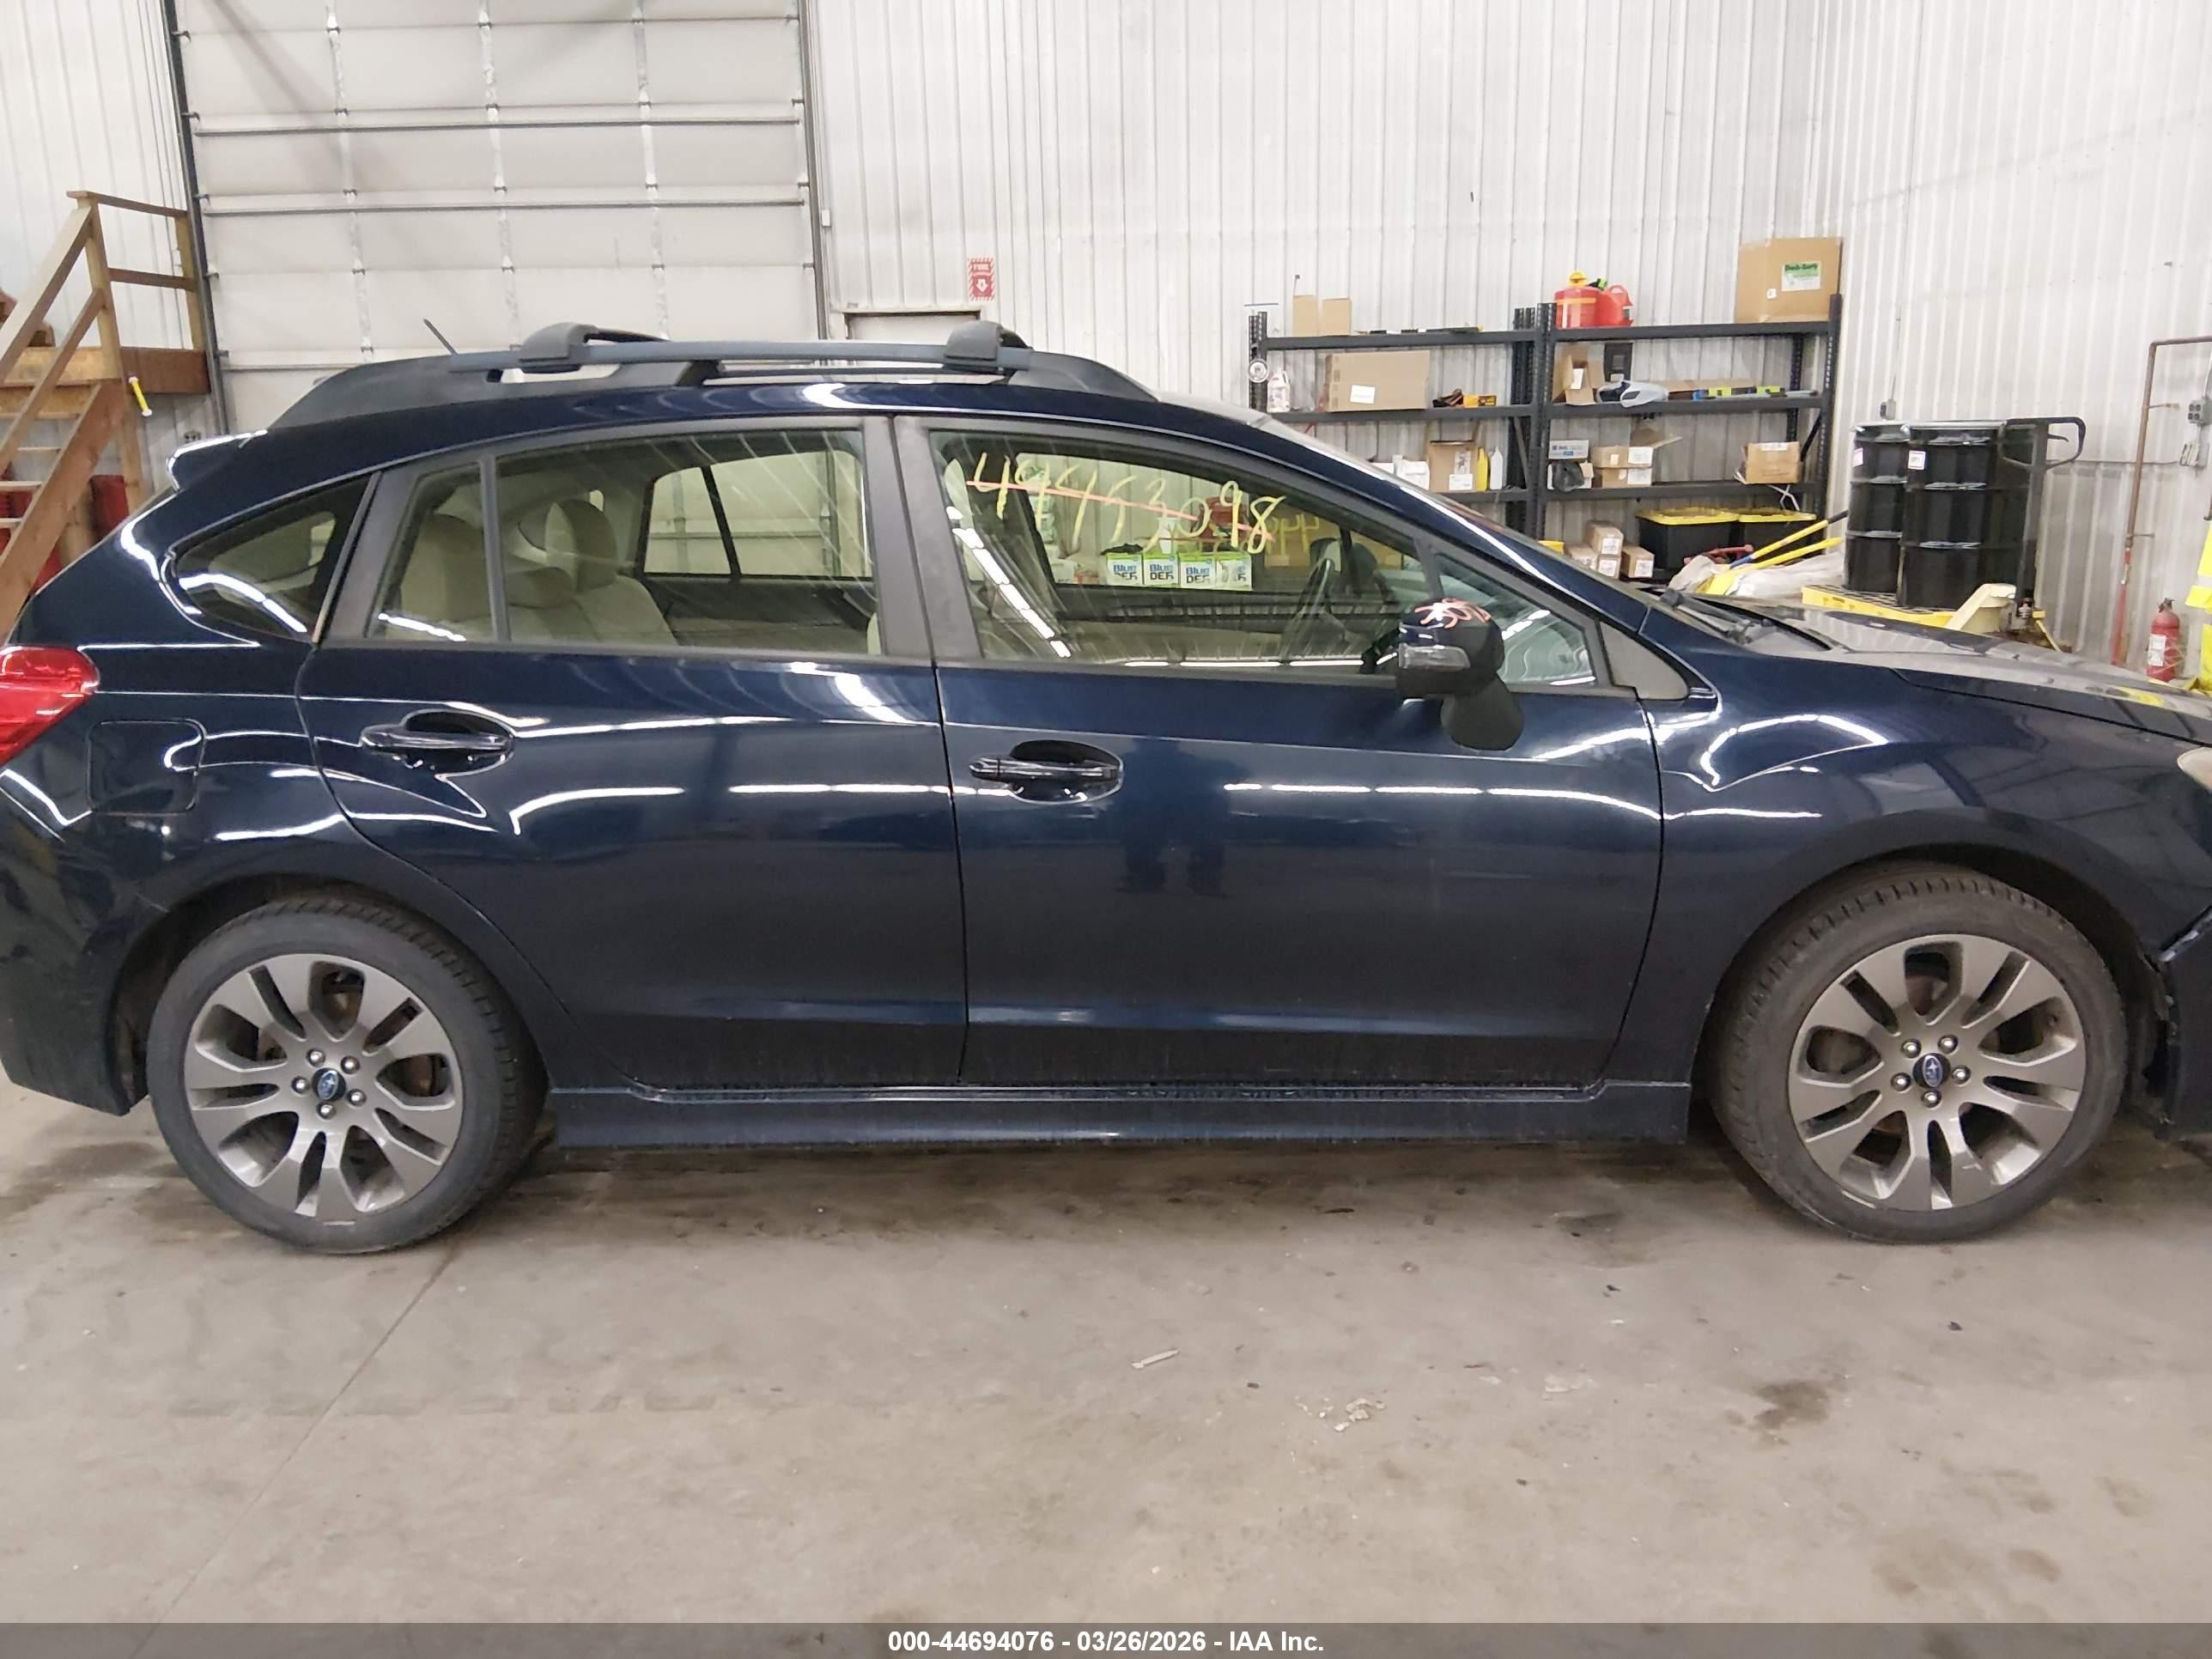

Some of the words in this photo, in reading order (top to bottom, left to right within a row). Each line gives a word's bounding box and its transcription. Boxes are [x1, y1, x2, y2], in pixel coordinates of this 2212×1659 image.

[1113, 563, 1137, 573] Blue
[1150, 563, 1174, 573] Blue
[1186, 566, 1210, 575] Blue
[1150, 572, 1175, 580] DEF
